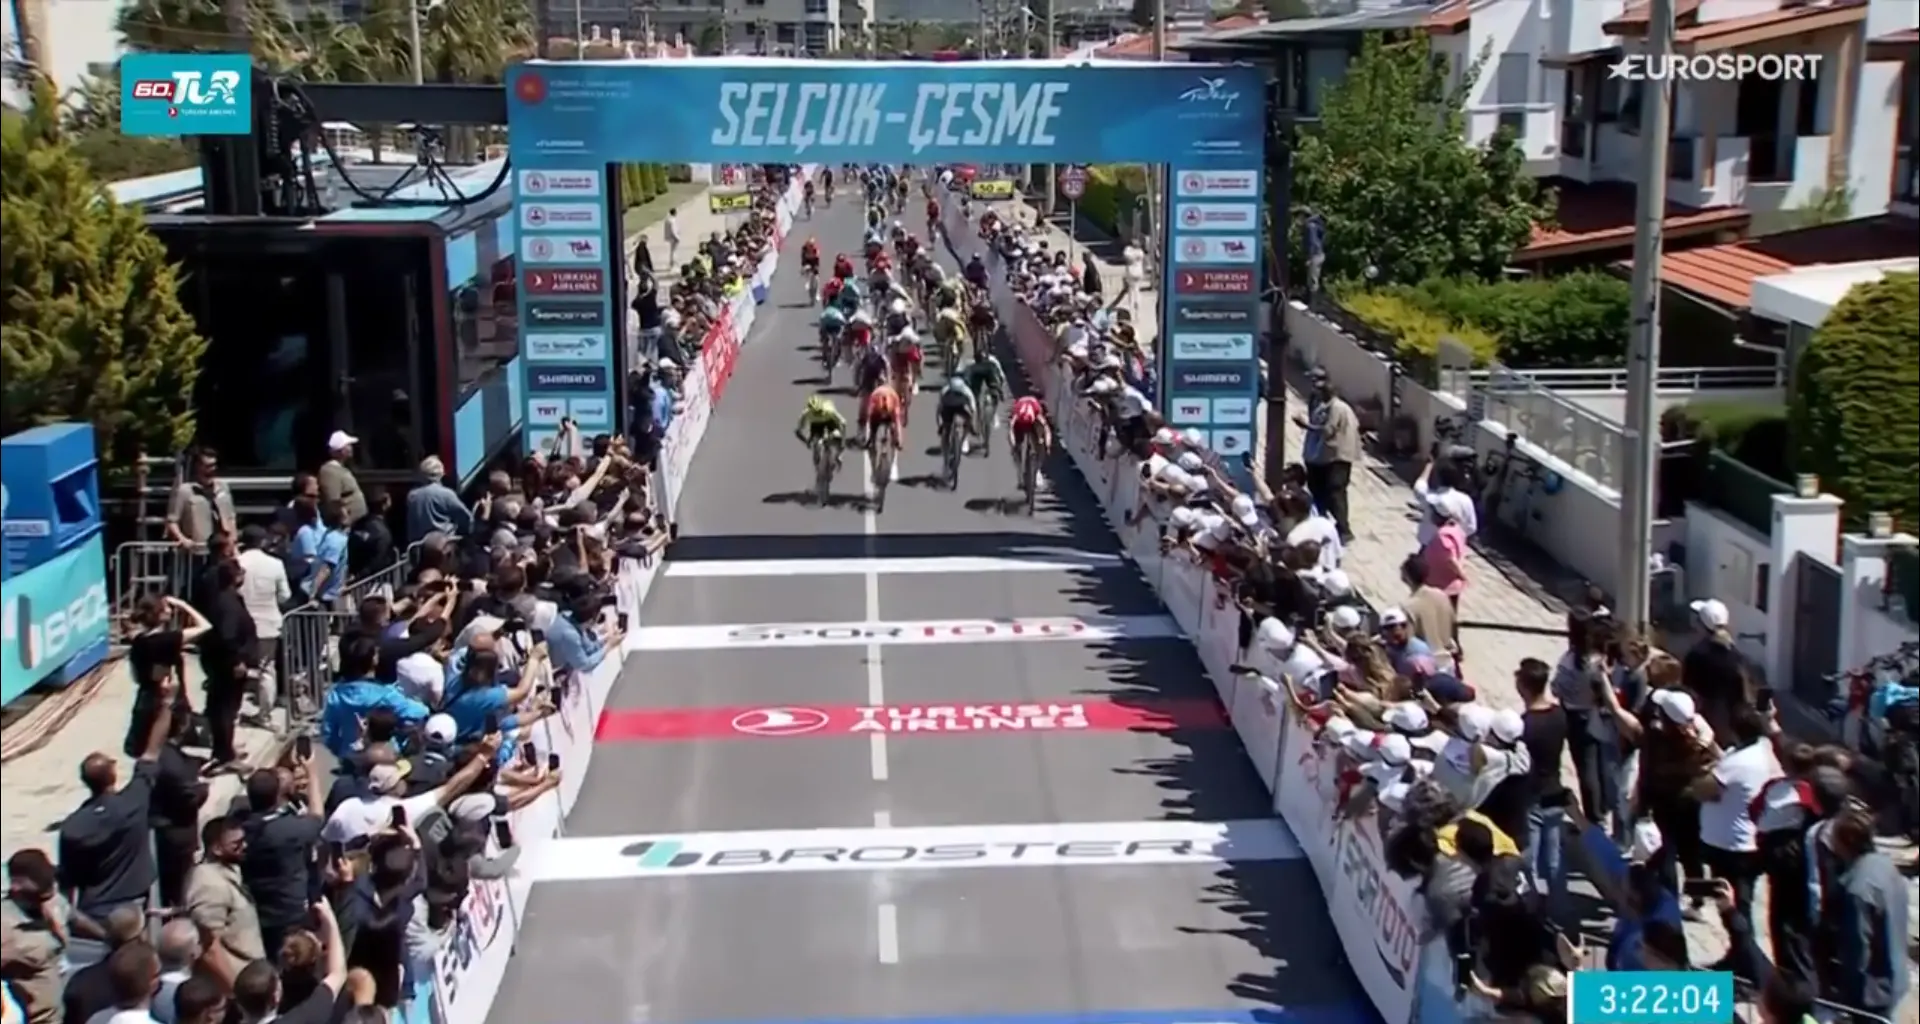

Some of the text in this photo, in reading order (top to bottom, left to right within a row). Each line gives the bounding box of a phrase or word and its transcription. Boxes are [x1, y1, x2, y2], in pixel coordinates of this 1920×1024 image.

[552, 272, 598, 283] TURKISH
[1204, 272, 1249, 283] TURKISH
[552, 282, 598, 293] AIRLINES
[1203, 282, 1249, 293] AIRLINES
[538, 374, 596, 385] SHIMANO
[1183, 374, 1241, 385] SHIMANO
[537, 406, 558, 417] TRT
[1180, 406, 1202, 417] TRT
[855, 703, 1084, 720] TURKISH
[849, 716, 1089, 732] AIRLINES
[706, 840, 1194, 867] BROSTER
